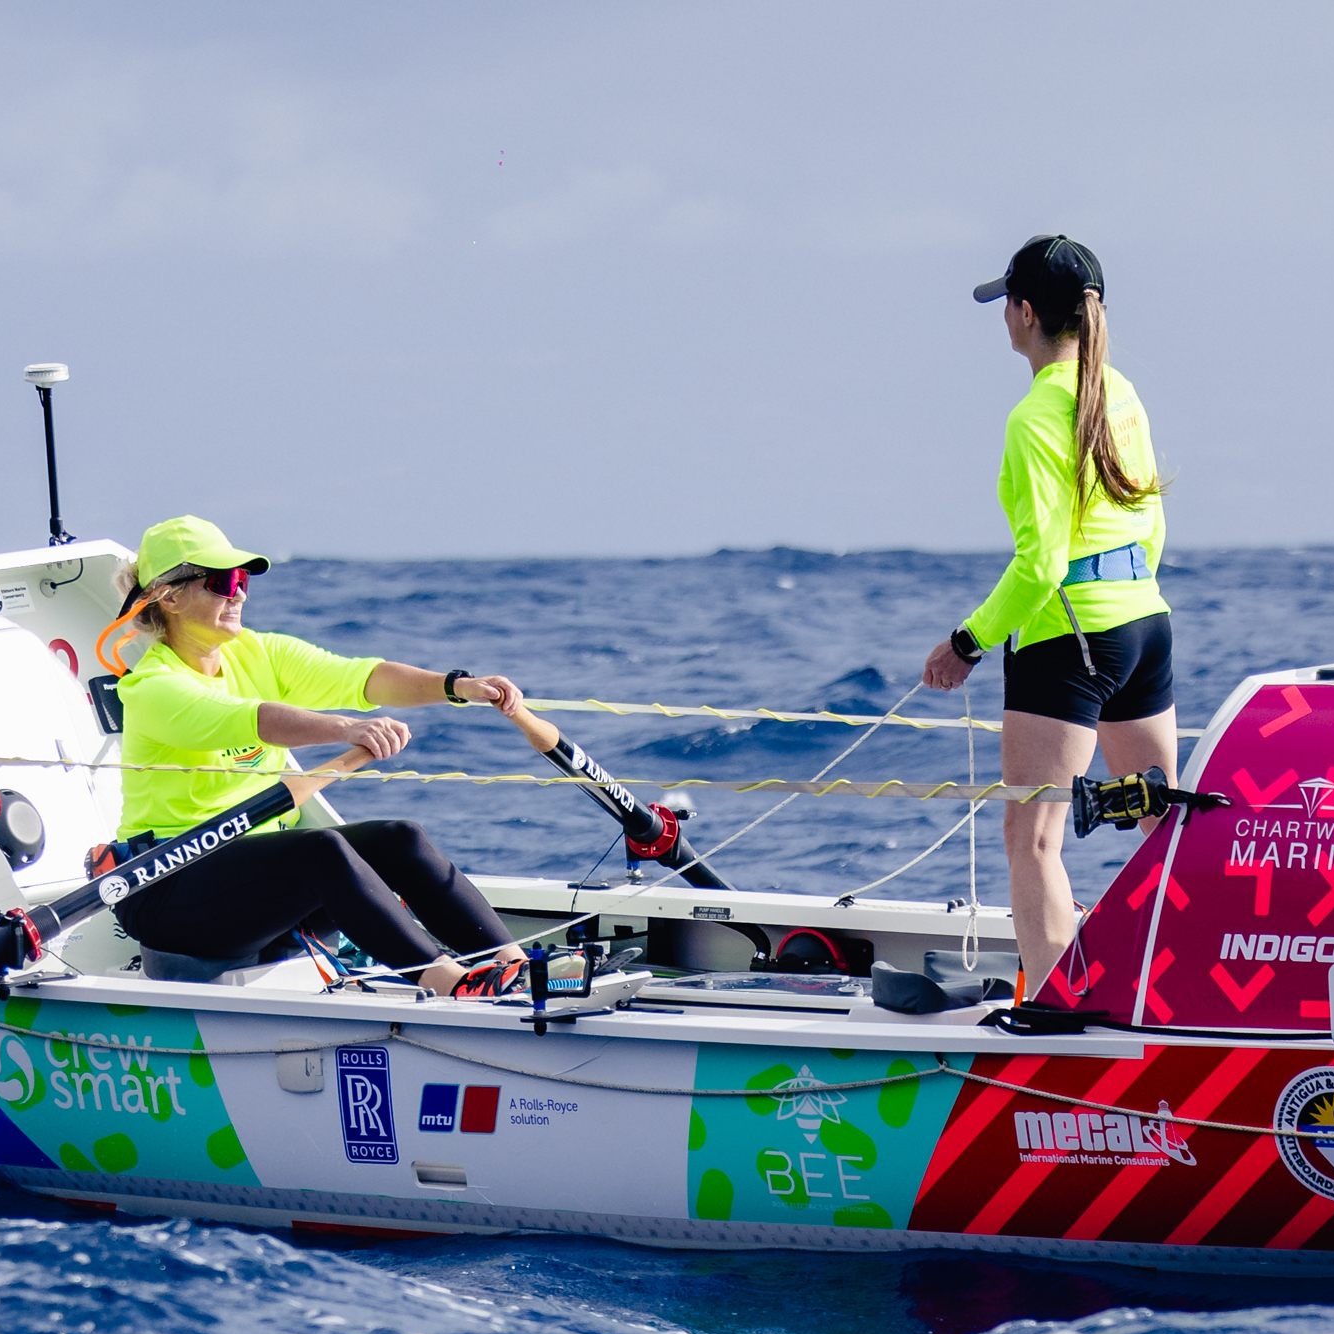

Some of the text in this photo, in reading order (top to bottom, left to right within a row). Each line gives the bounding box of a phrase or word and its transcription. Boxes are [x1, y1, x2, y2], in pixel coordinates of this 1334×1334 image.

[132, 812, 253, 886] RANNOCH
[45, 1031, 152, 1071] crew
[342, 1053, 383, 1065] ROLLS
[50, 1066, 186, 1116] smart
[509, 1098, 578, 1114] A Rolls-Royce
[1285, 1080, 1324, 1127] ANTIGUA
[1325, 1078, 1334, 1090] &
[421, 1113, 453, 1126] mtu
[510, 1114, 550, 1125] solution
[351, 1145, 393, 1158] ROYCE
[1019, 1153, 1170, 1167] International Marine Consultants
[764, 1150, 870, 1200] BEE
